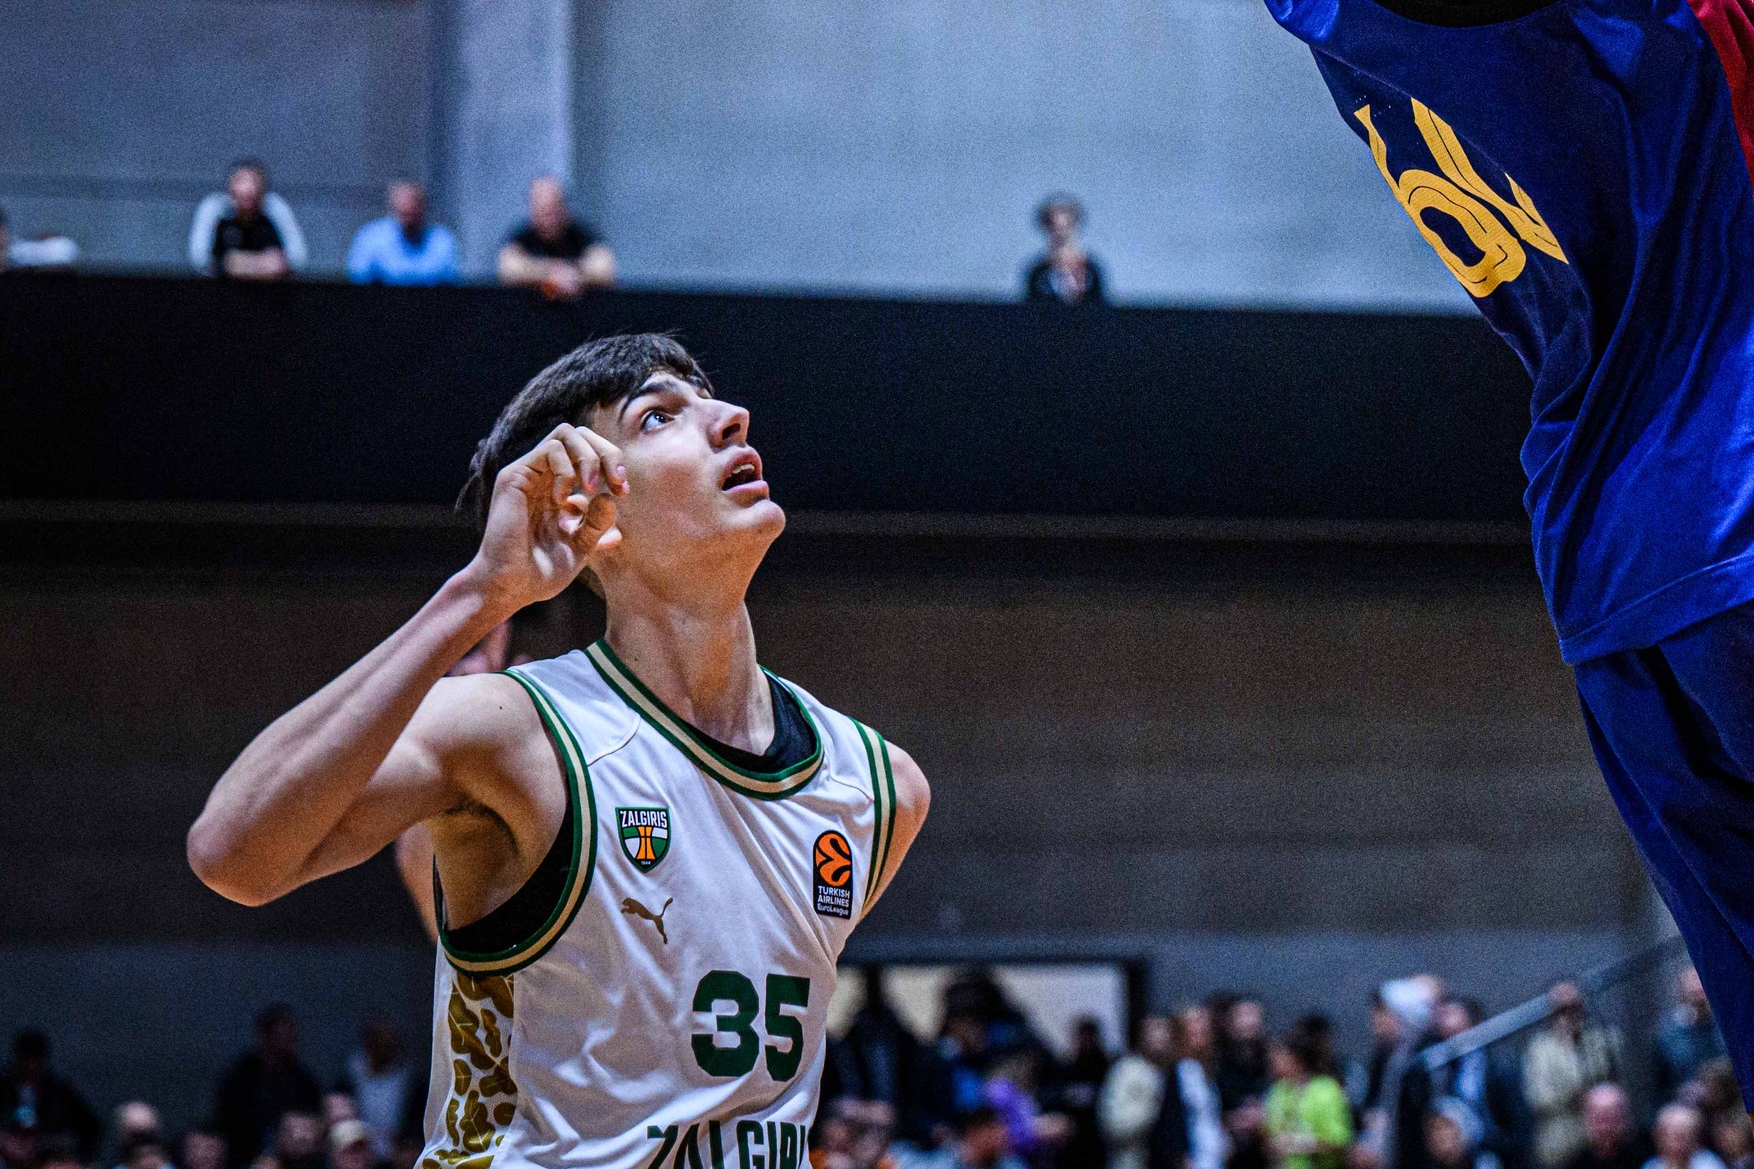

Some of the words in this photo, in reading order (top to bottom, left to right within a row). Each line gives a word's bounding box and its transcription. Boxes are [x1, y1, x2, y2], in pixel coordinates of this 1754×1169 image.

[818, 886, 850, 898] TURKISH
[817, 895, 849, 907] AIRLINES
[817, 903, 849, 915] EuroLeague
[691, 970, 811, 1082] 35
[647, 1120, 806, 1169] ZALGIRI
